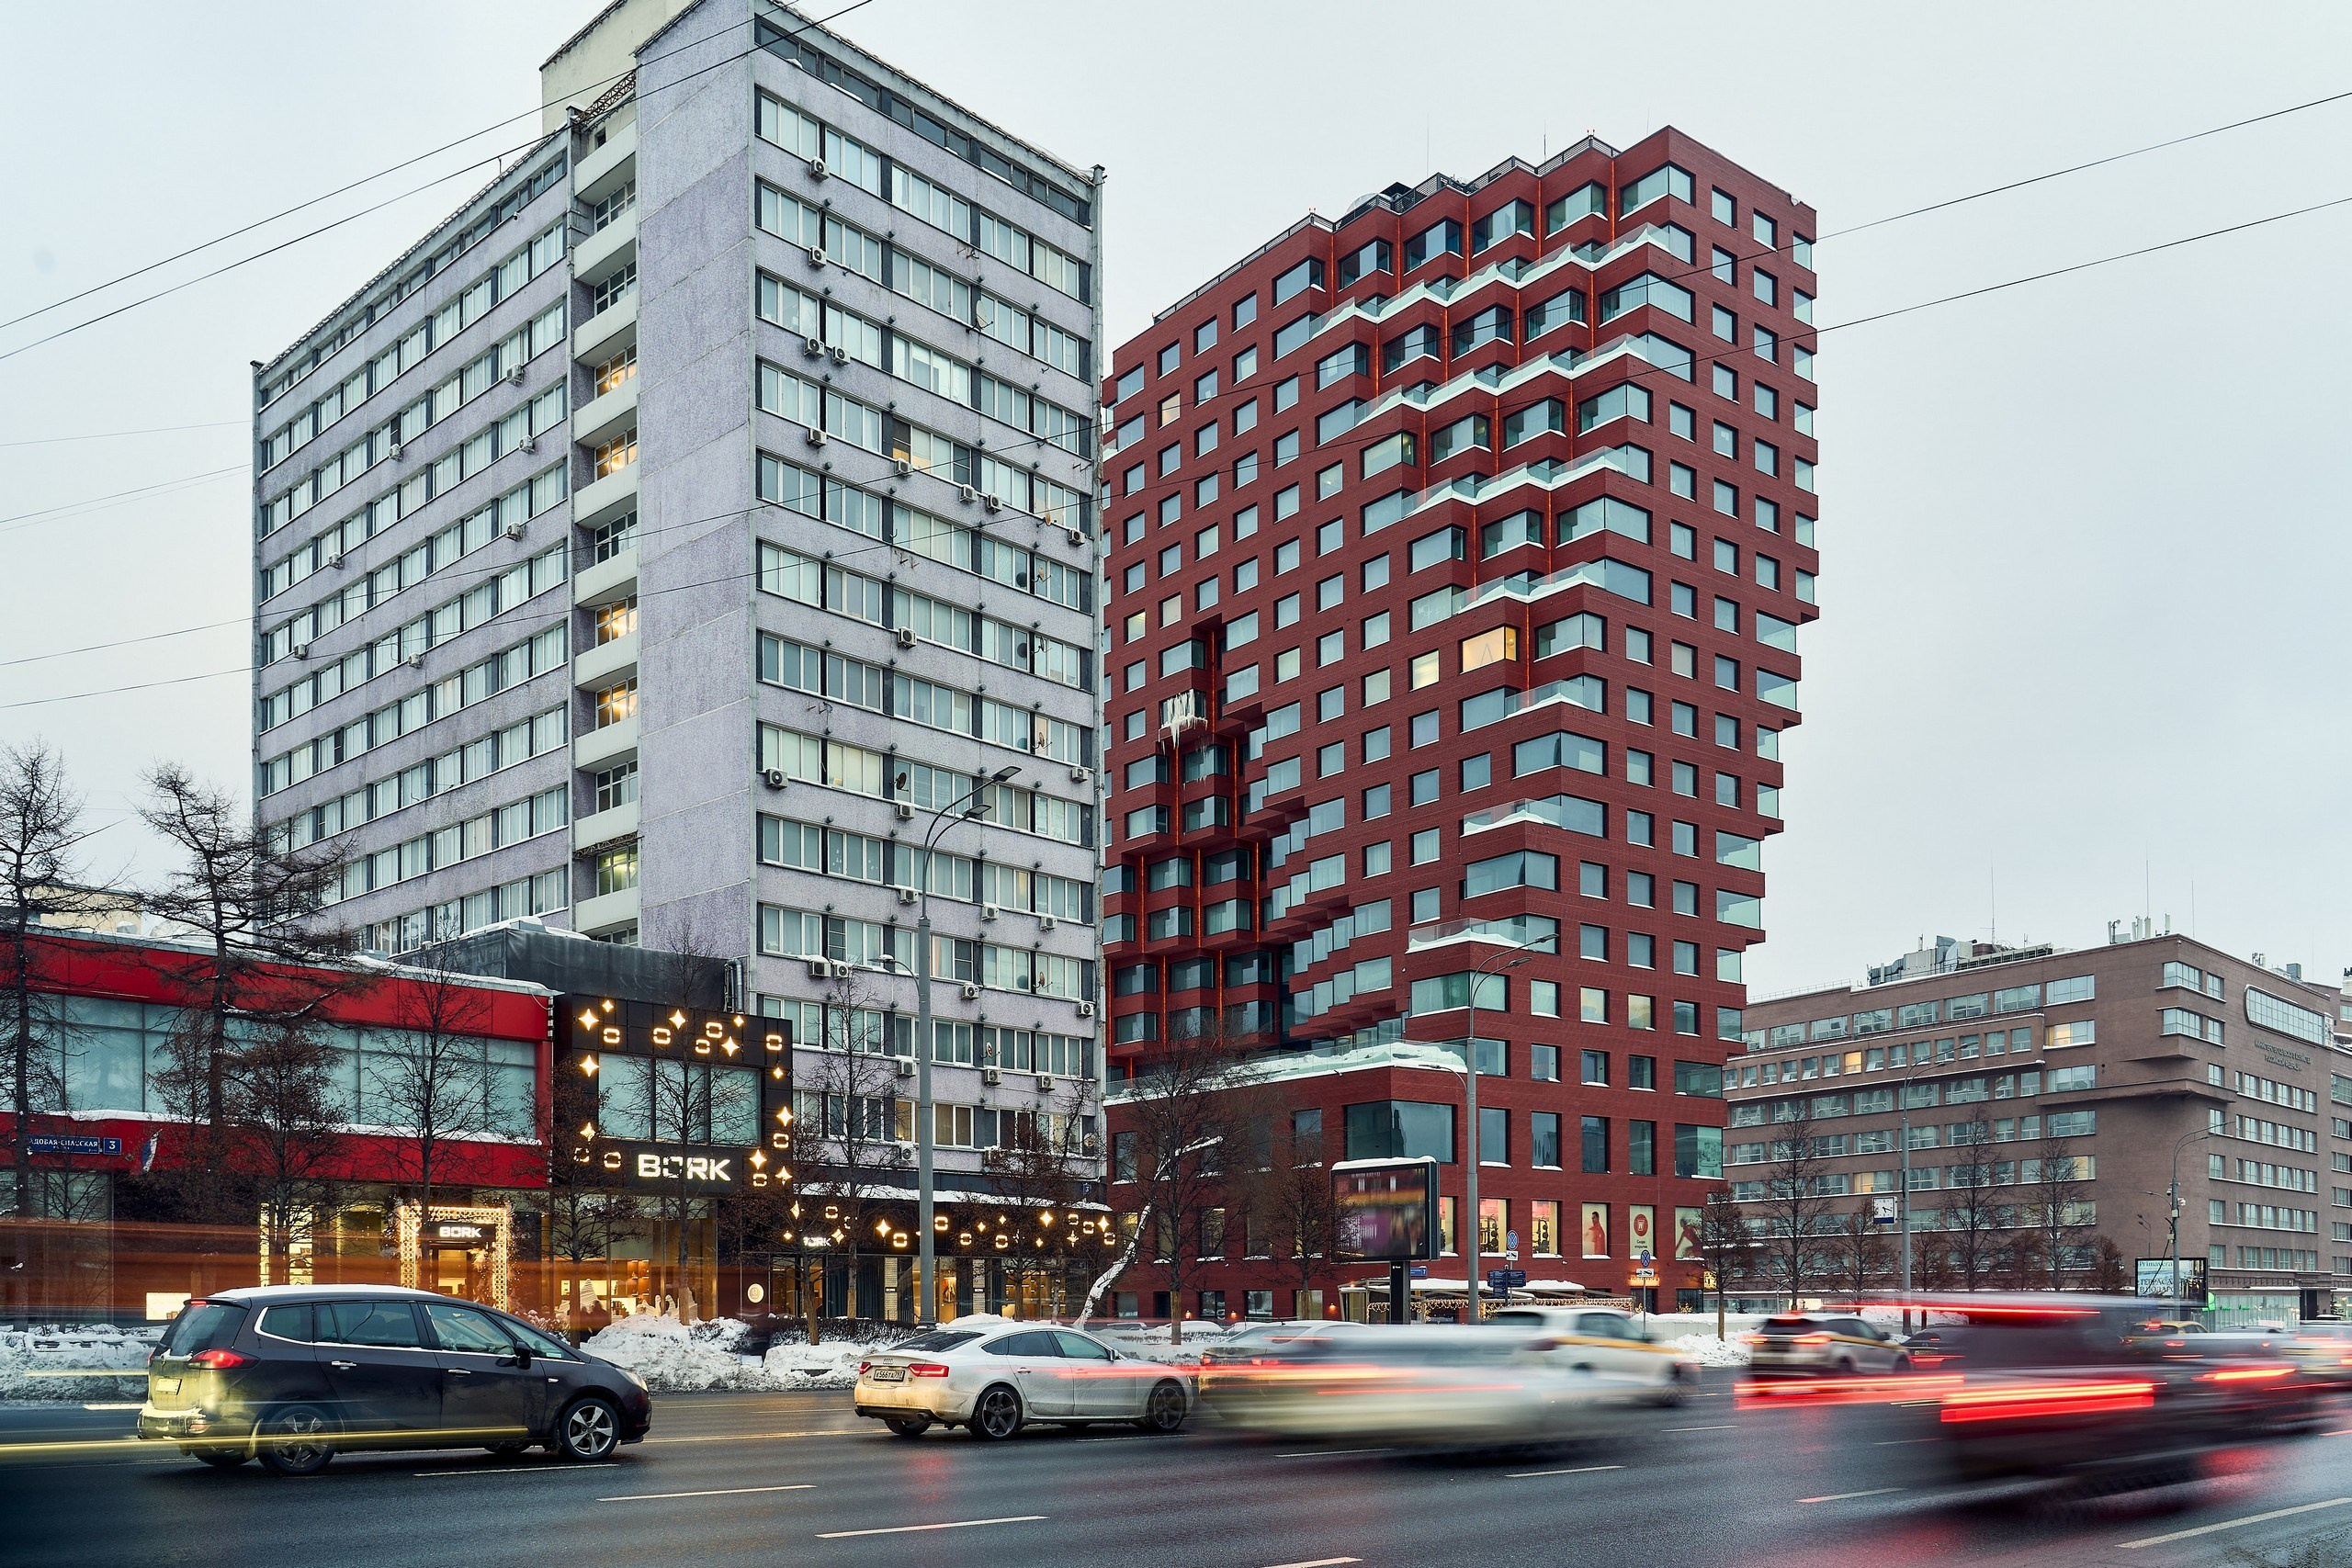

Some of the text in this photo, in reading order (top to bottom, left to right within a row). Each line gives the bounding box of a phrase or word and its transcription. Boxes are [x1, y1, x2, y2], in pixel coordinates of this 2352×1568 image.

[108, 1141, 116, 1149] 3
[638, 1155, 731, 1181] BORK
[439, 1226, 482, 1238] BORK
